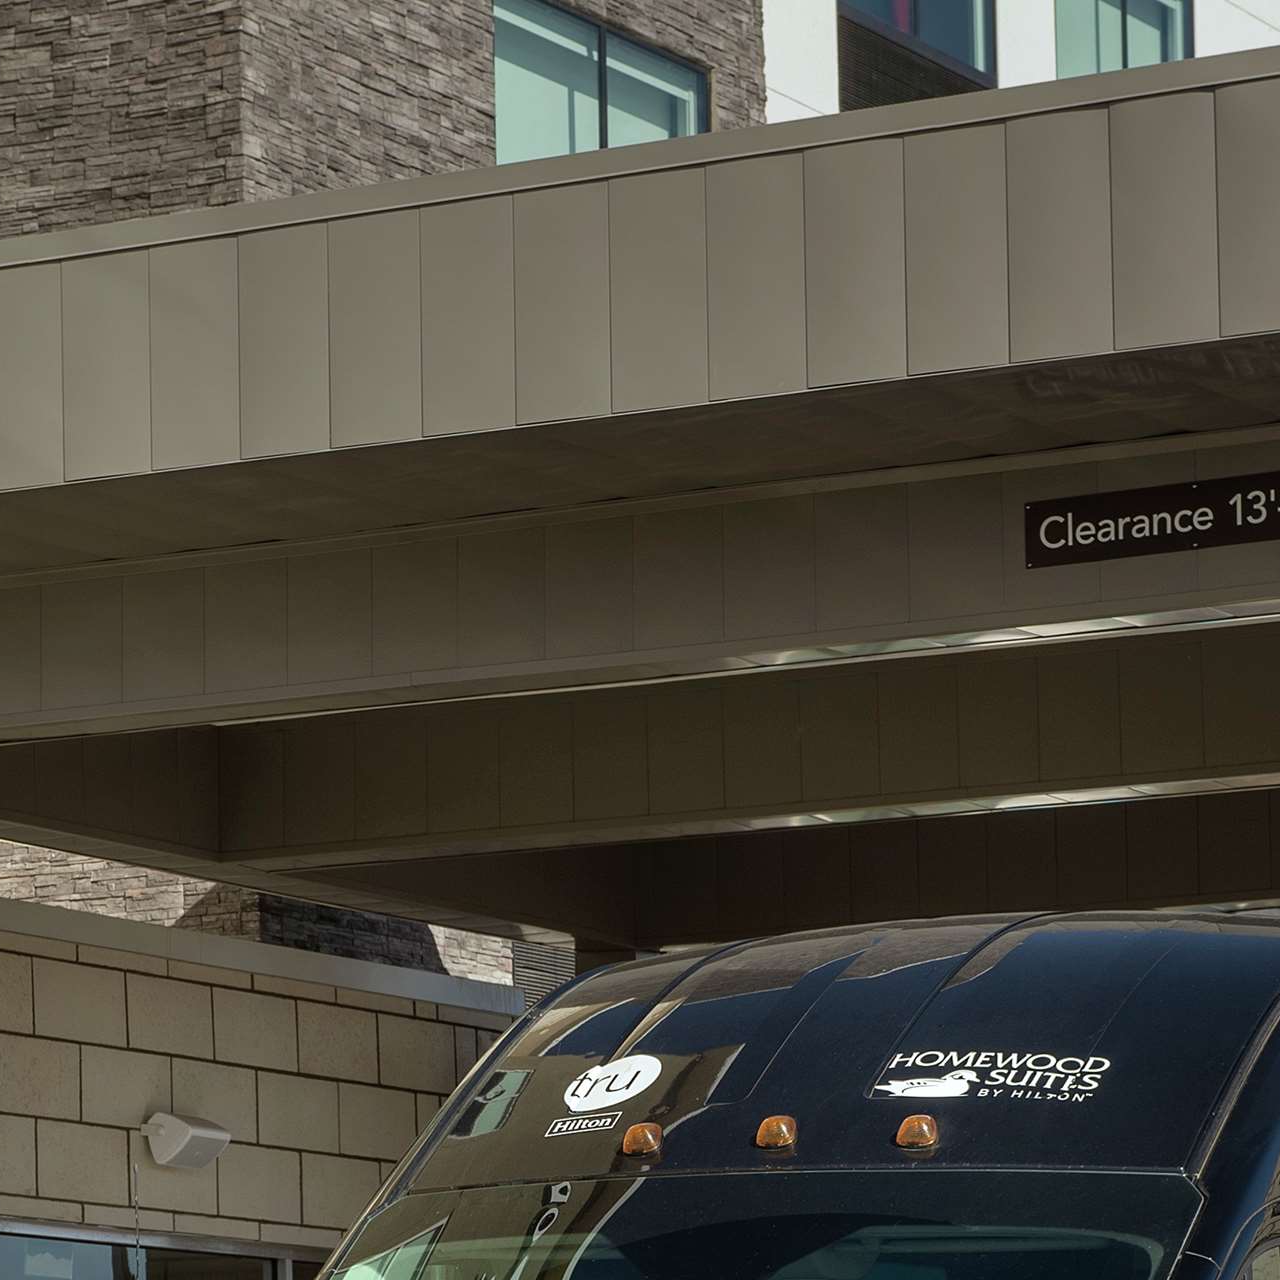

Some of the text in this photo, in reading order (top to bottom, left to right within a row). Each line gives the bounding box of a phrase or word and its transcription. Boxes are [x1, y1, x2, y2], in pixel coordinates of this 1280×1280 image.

[1039, 507, 1215, 549] Clearance
[888, 1050, 1111, 1074] HOMEWOOD
[570, 1070, 641, 1099] tru
[984, 1069, 1102, 1092] SUITES
[976, 1088, 1004, 1098] BY
[552, 1117, 613, 1134] Hilton
